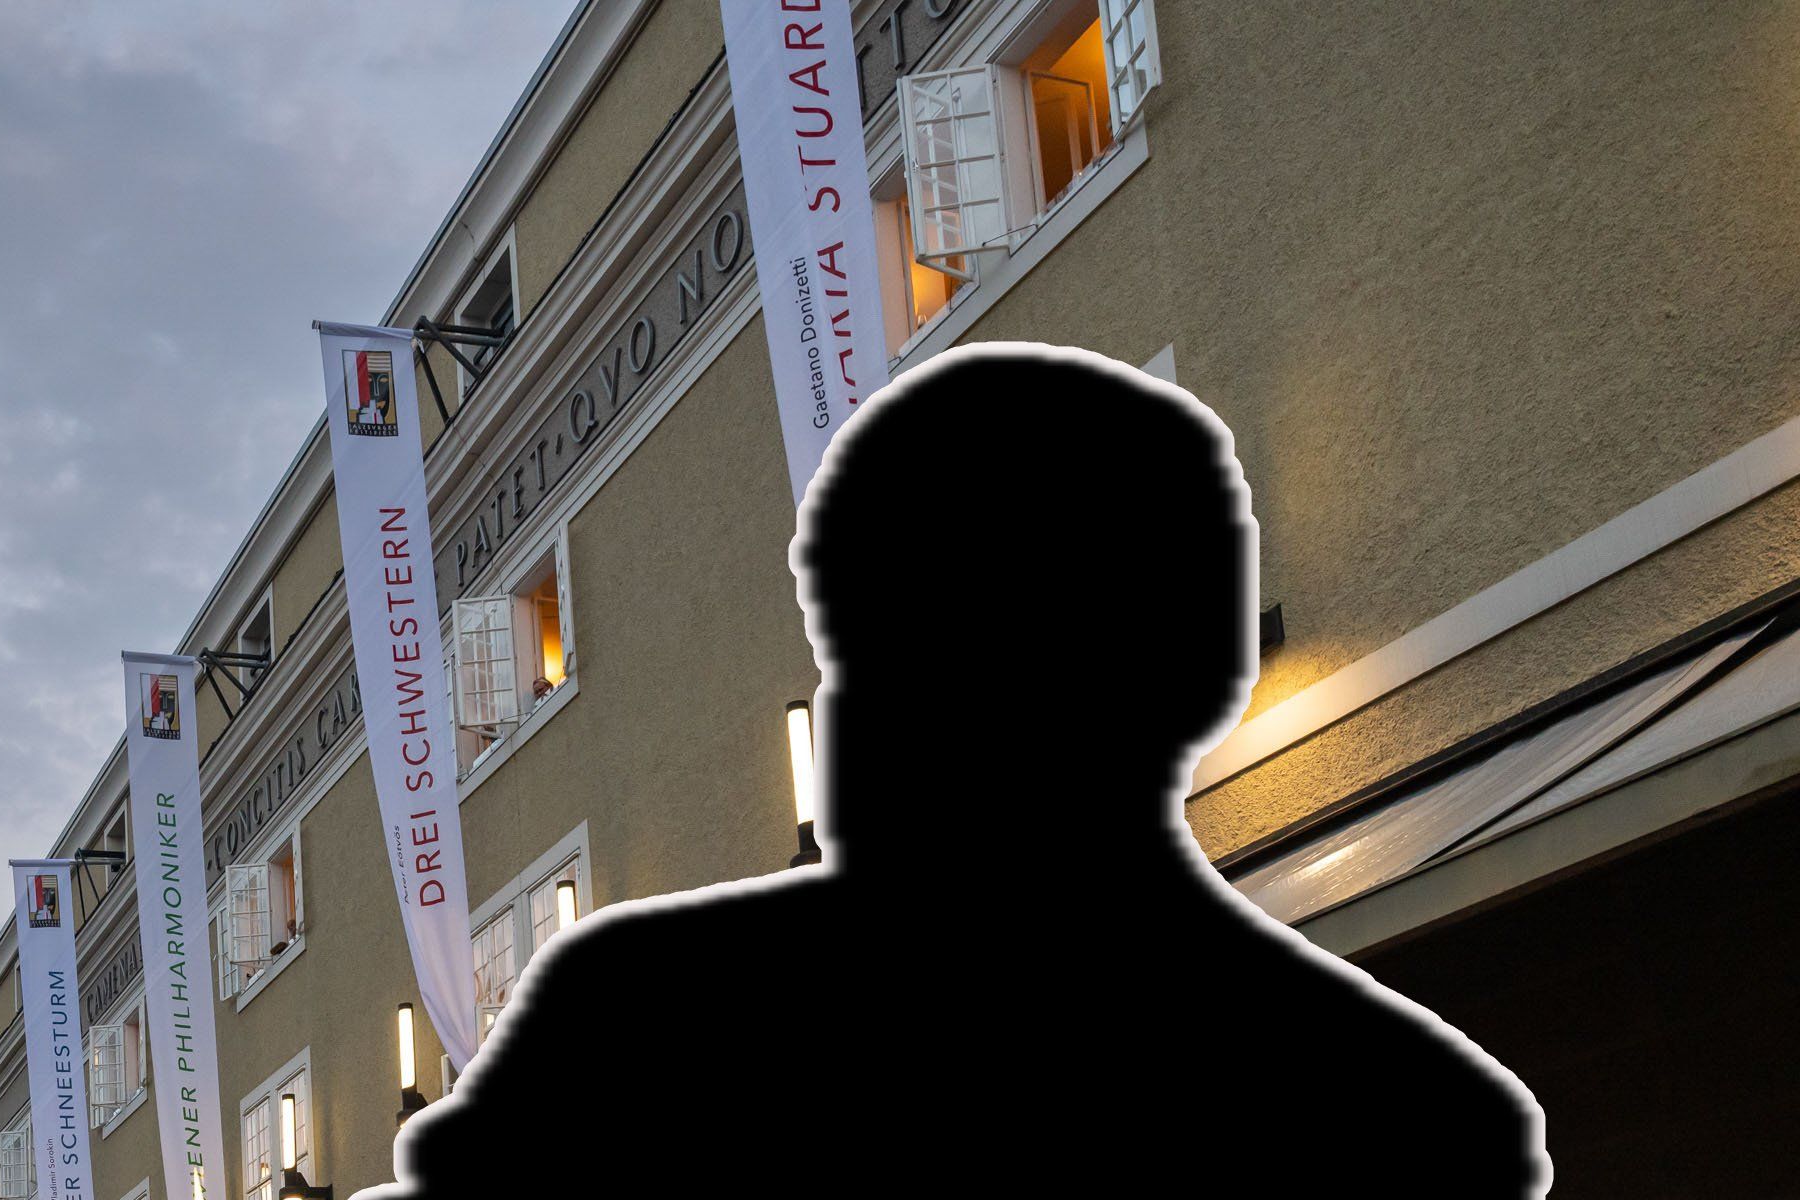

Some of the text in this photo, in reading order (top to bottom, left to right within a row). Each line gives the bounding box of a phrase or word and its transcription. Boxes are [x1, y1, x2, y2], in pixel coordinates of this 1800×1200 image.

[455, 439, 548, 587] PATET
[569, 315, 656, 444] QVO
[790, 256, 830, 429] Gaetano Donizetti
[379, 507, 446, 907] DREI SCHWESTERN
[156, 791, 196, 1074] PHILHARMONIKER
[46, 1138, 56, 1169] Sorokin
[49, 970, 79, 1165] SCHNEESTURM
